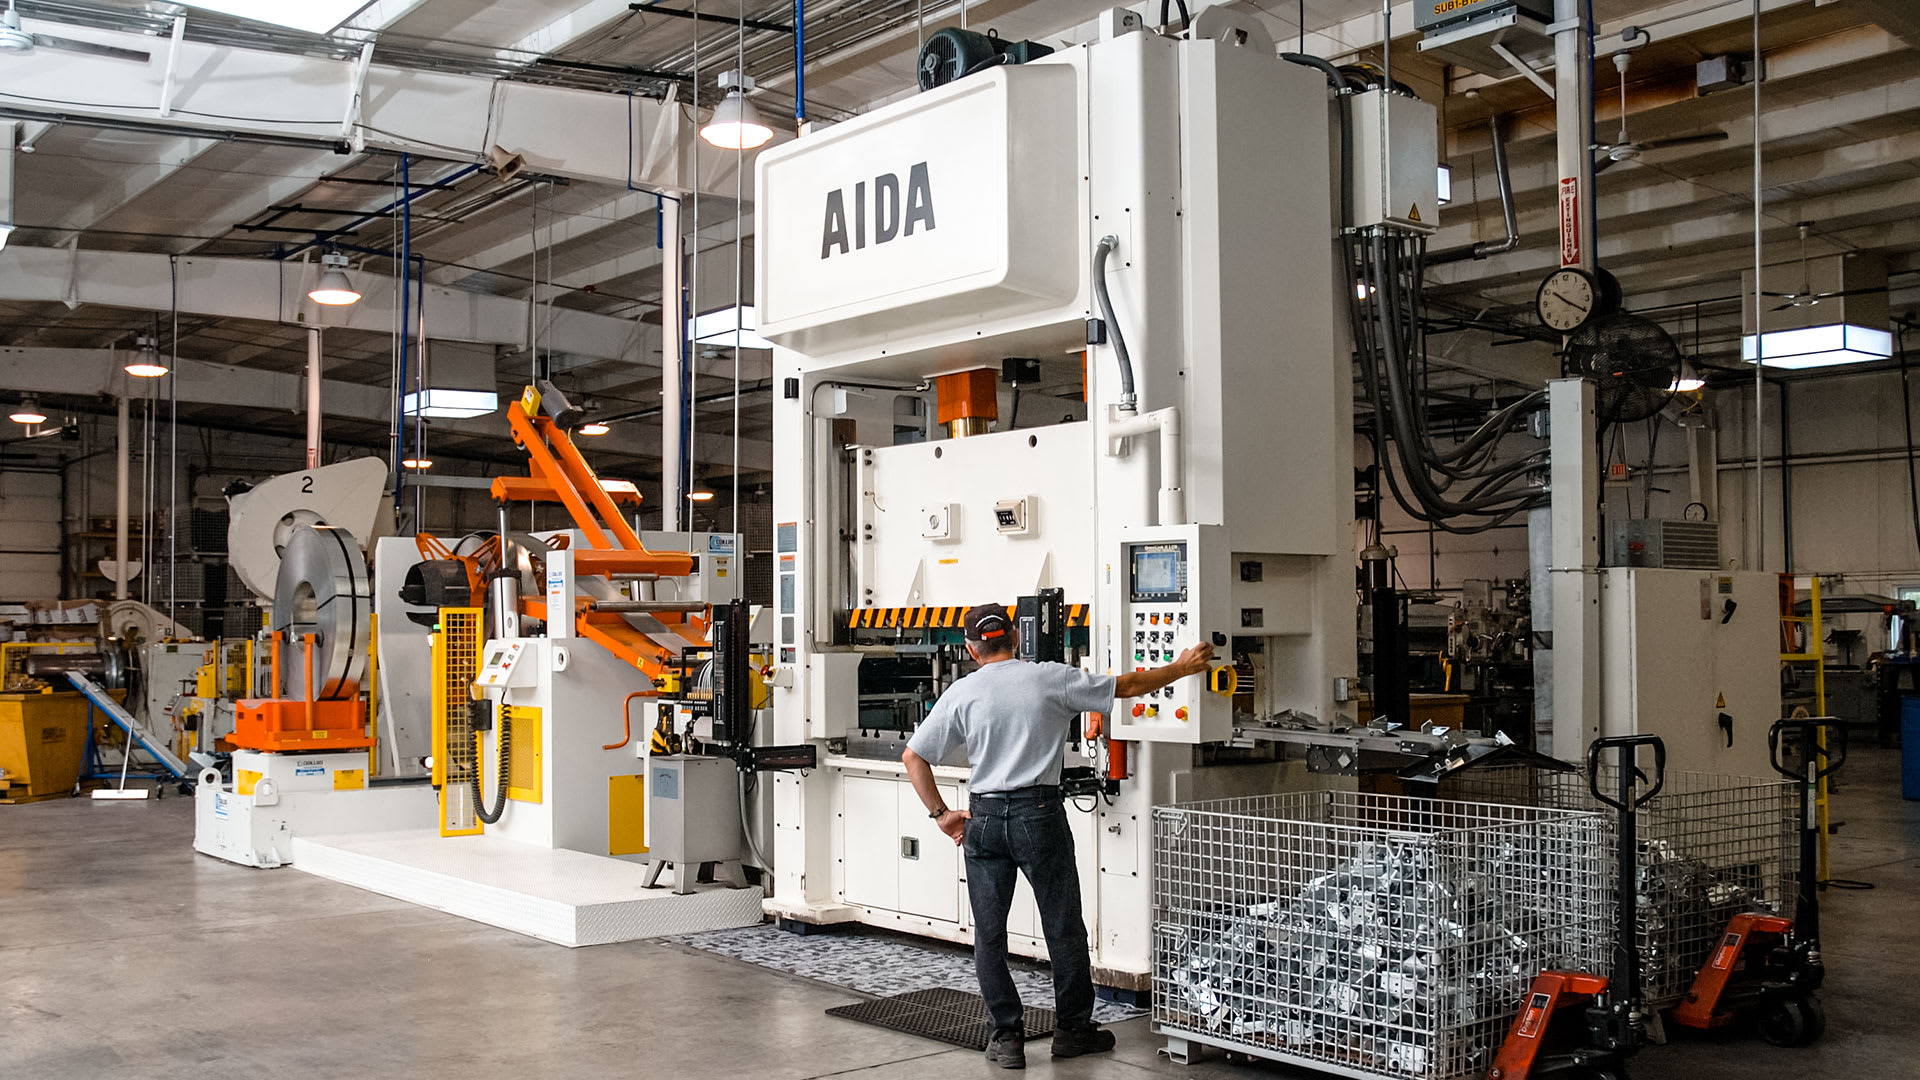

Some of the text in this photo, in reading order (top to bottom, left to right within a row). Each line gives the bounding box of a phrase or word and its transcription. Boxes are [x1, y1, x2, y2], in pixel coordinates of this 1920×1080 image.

[1433, 0, 1478, 14] SUB1-B
[821, 161, 936, 260] AIDA
[1554, 319, 1559, 327] 7
[1575, 316, 1581, 324] 5
[302, 475, 313, 493] 2
